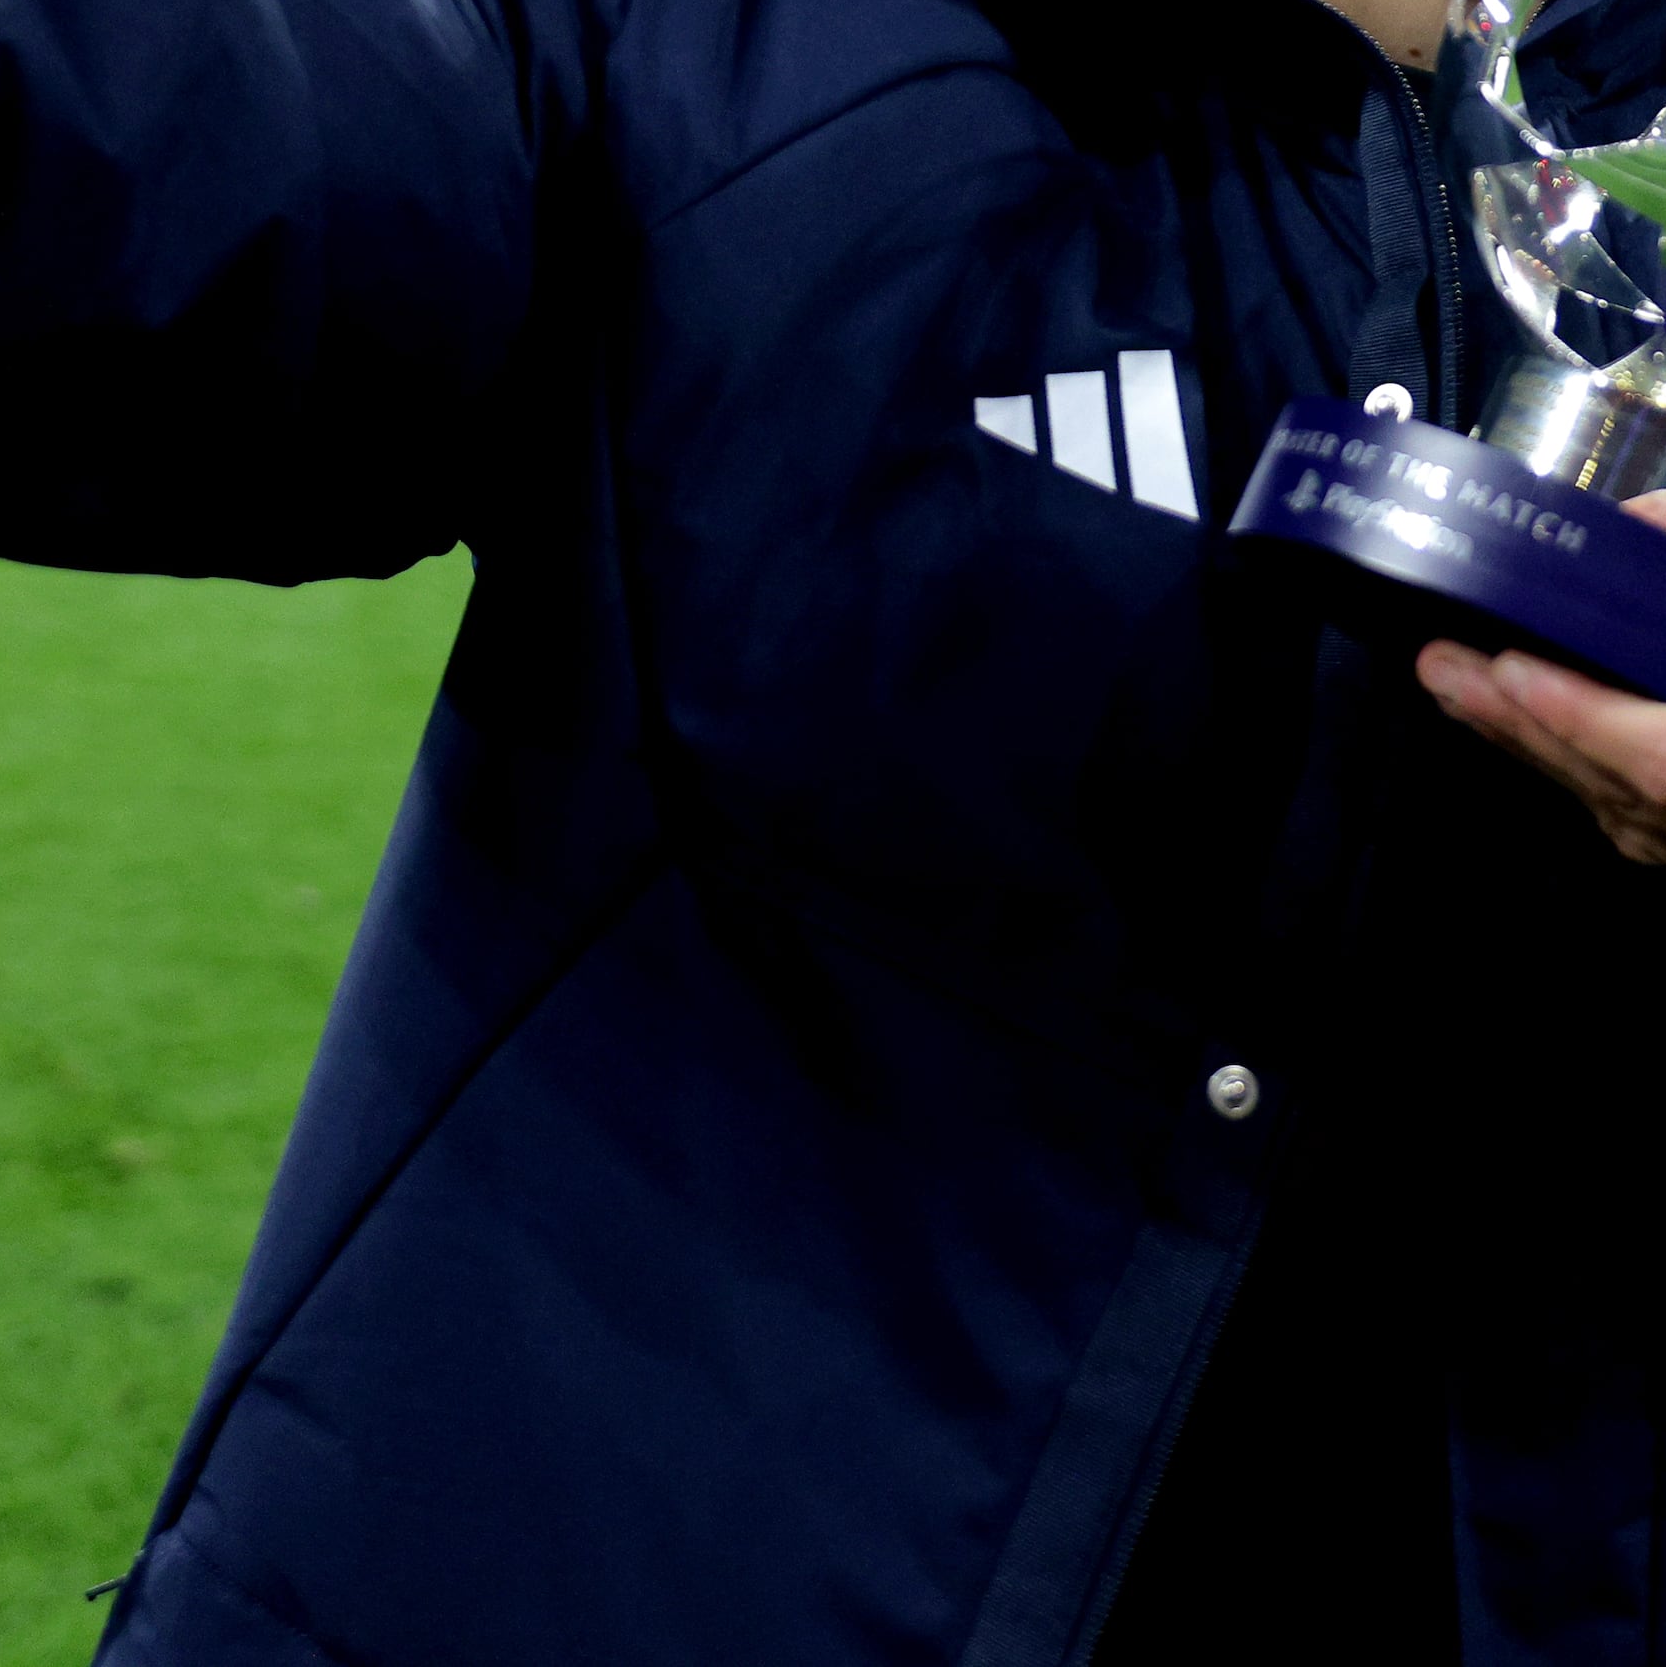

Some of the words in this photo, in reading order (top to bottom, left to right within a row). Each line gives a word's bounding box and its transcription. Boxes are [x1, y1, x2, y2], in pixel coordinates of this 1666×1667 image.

[1341, 438, 1383, 469] OF
[1388, 451, 1453, 500] THE
[1457, 480, 1588, 553] MATCH
